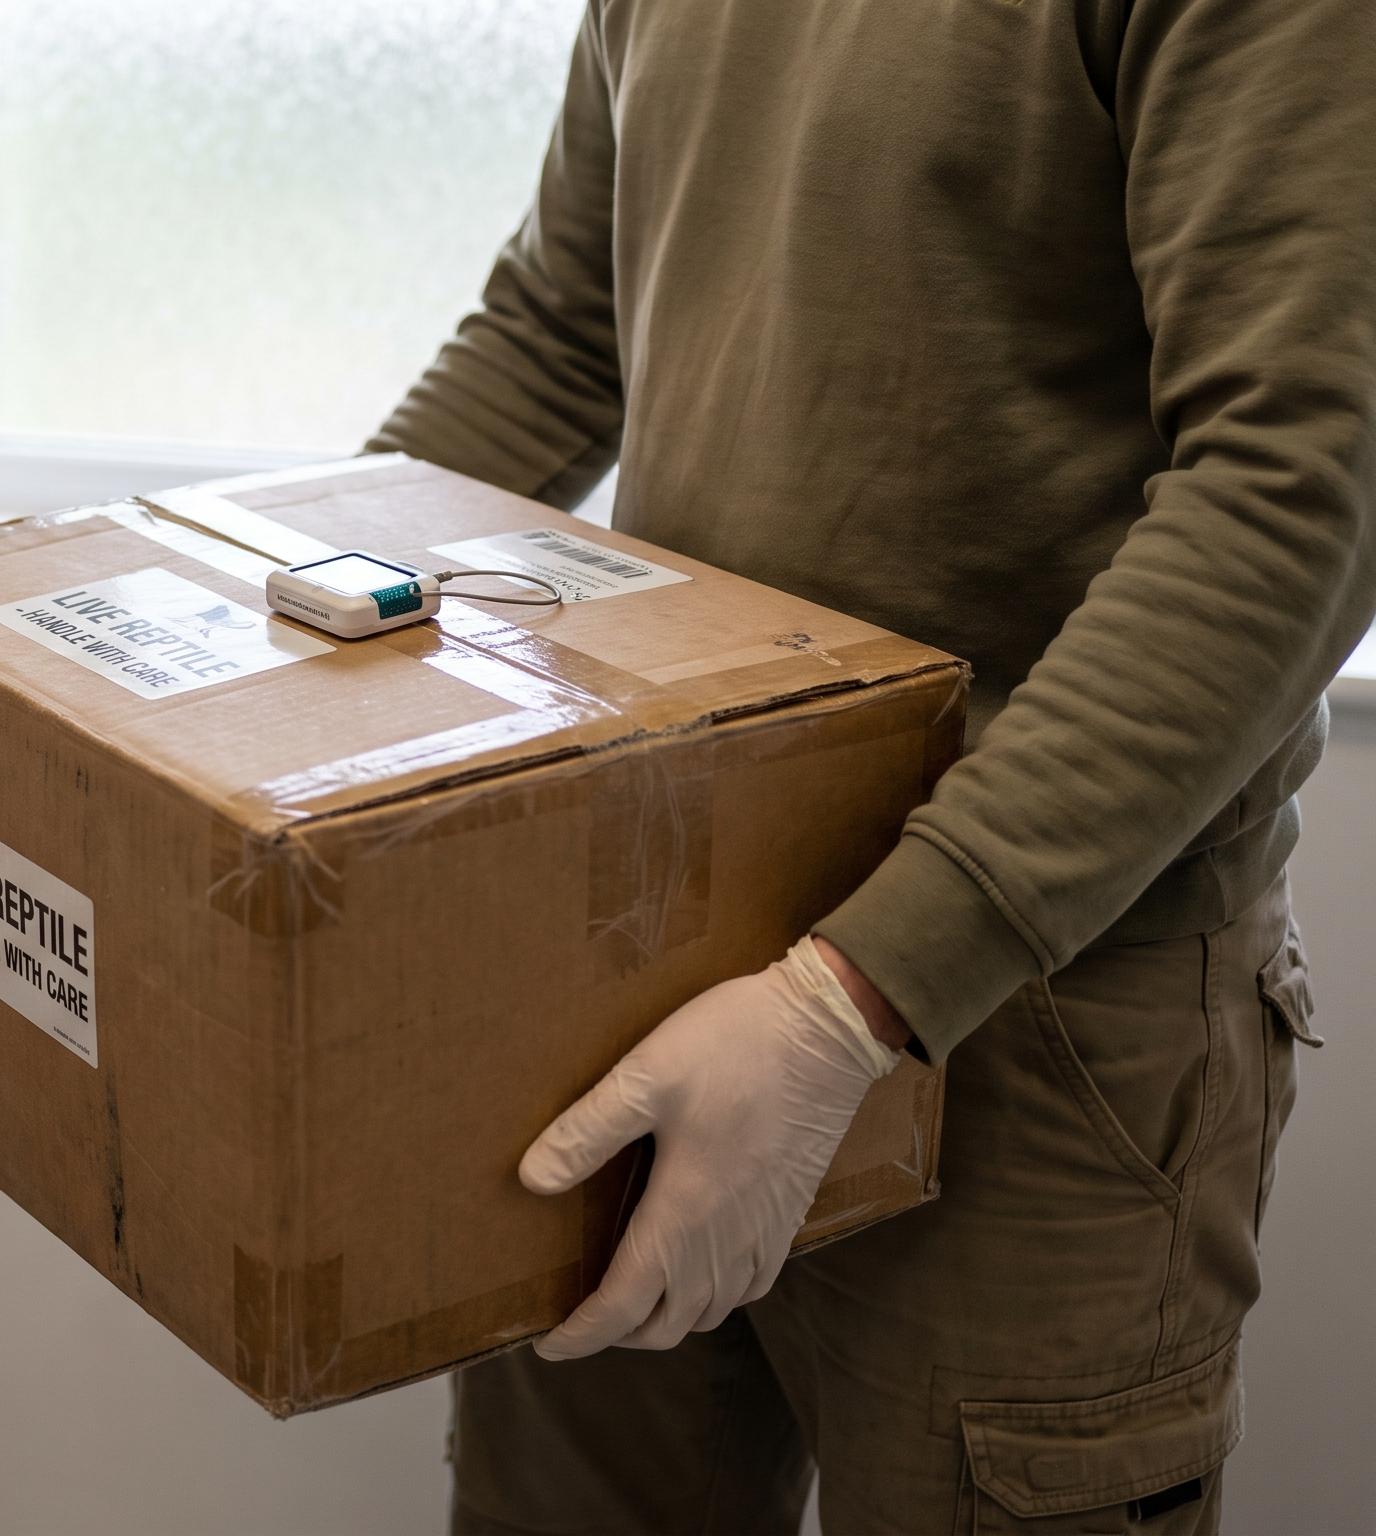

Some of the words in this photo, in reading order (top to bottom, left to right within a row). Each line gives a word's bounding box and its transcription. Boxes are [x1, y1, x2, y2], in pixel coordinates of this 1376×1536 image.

[52, 591, 130, 624] LIVE
[111, 619, 240, 678] REPTILE
[82, 640, 138, 666] WITH
[122, 662, 180, 688] CARE
[4, 938, 42, 991] WITH
[46, 970, 89, 1023] CARE
